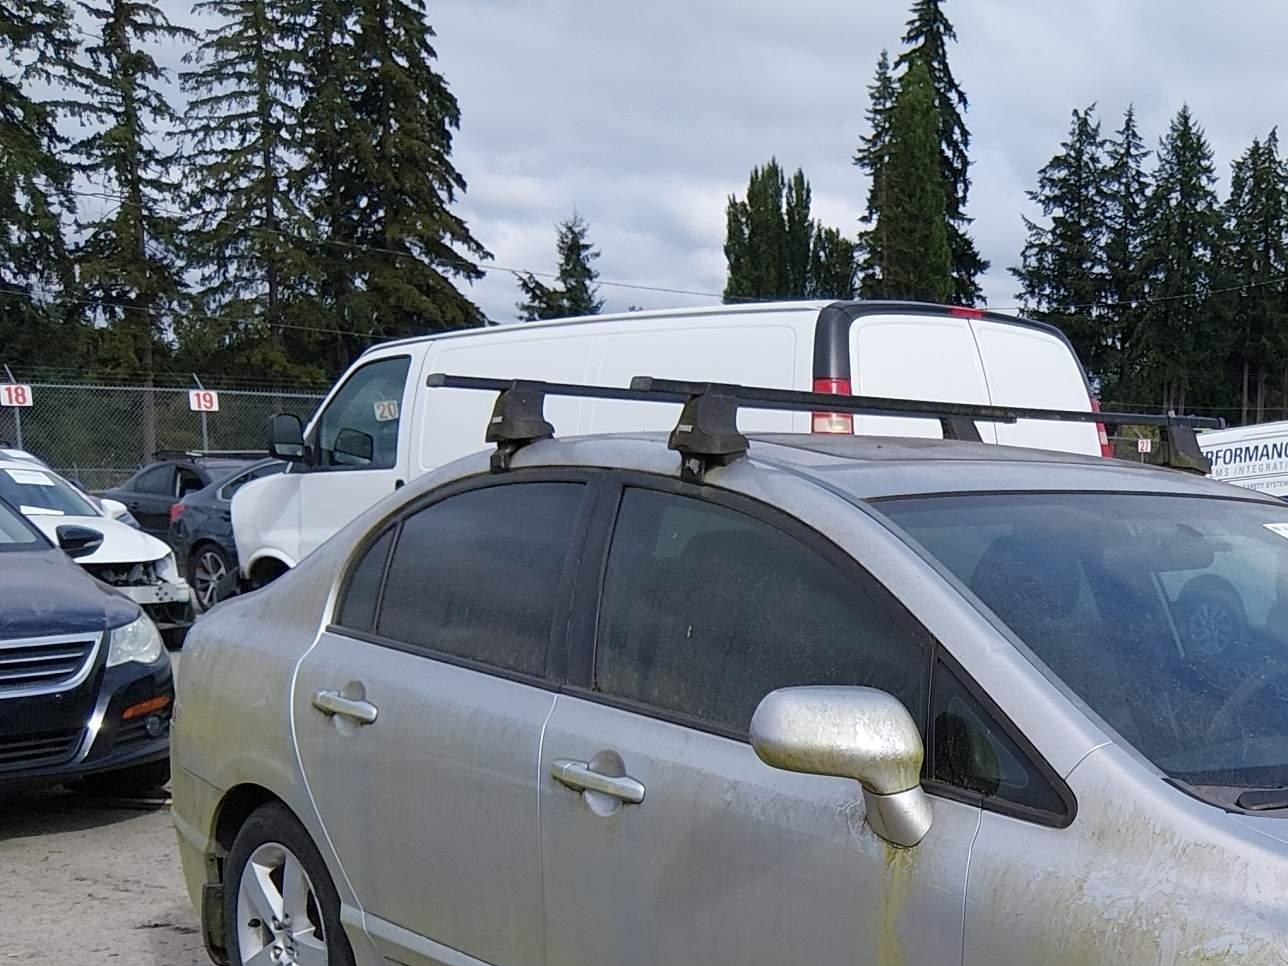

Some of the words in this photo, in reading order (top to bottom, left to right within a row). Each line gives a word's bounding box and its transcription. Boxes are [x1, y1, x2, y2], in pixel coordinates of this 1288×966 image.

[4, 386, 27, 405] 18
[194, 392, 214, 410] 19
[377, 402, 397, 419] 20
